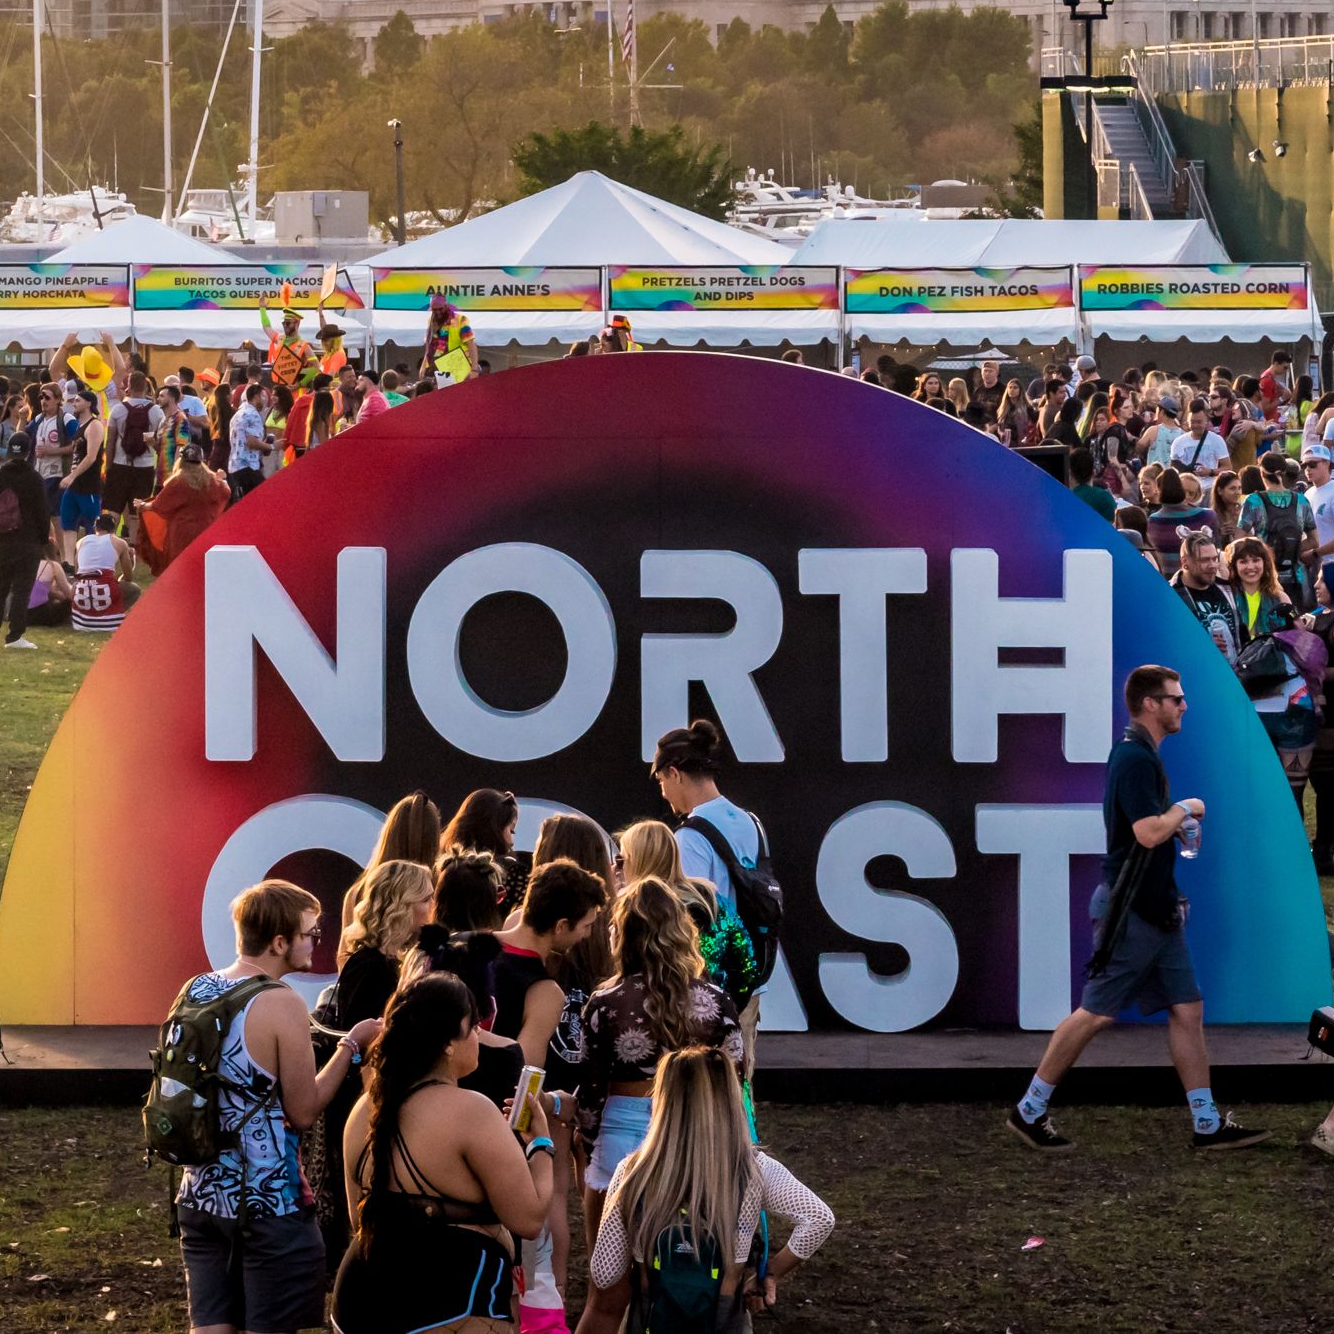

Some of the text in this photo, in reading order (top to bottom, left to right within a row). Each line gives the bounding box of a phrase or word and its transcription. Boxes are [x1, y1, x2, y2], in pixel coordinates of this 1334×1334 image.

[45, 277, 108, 286] PINEAPPLE
[174, 277, 323, 286] BURRITOS SUPER NACHOS
[642, 277, 805, 286] PRETZELS PRETZEL DOGS
[426, 284, 550, 297] AUNTIE ANNE'S
[879, 285, 1038, 297] DON PEZ FISH TACOS
[1097, 283, 1289, 294] ROBBIES ROASTED CORN
[23, 290, 86, 299] HORCHATA
[188, 290, 309, 299] TACOS QUESADIAS
[694, 291, 754, 301] AND DIPS
[74, 583, 113, 612] 88
[204, 541, 1113, 764] NORTH
[201, 792, 1105, 1034] CST
